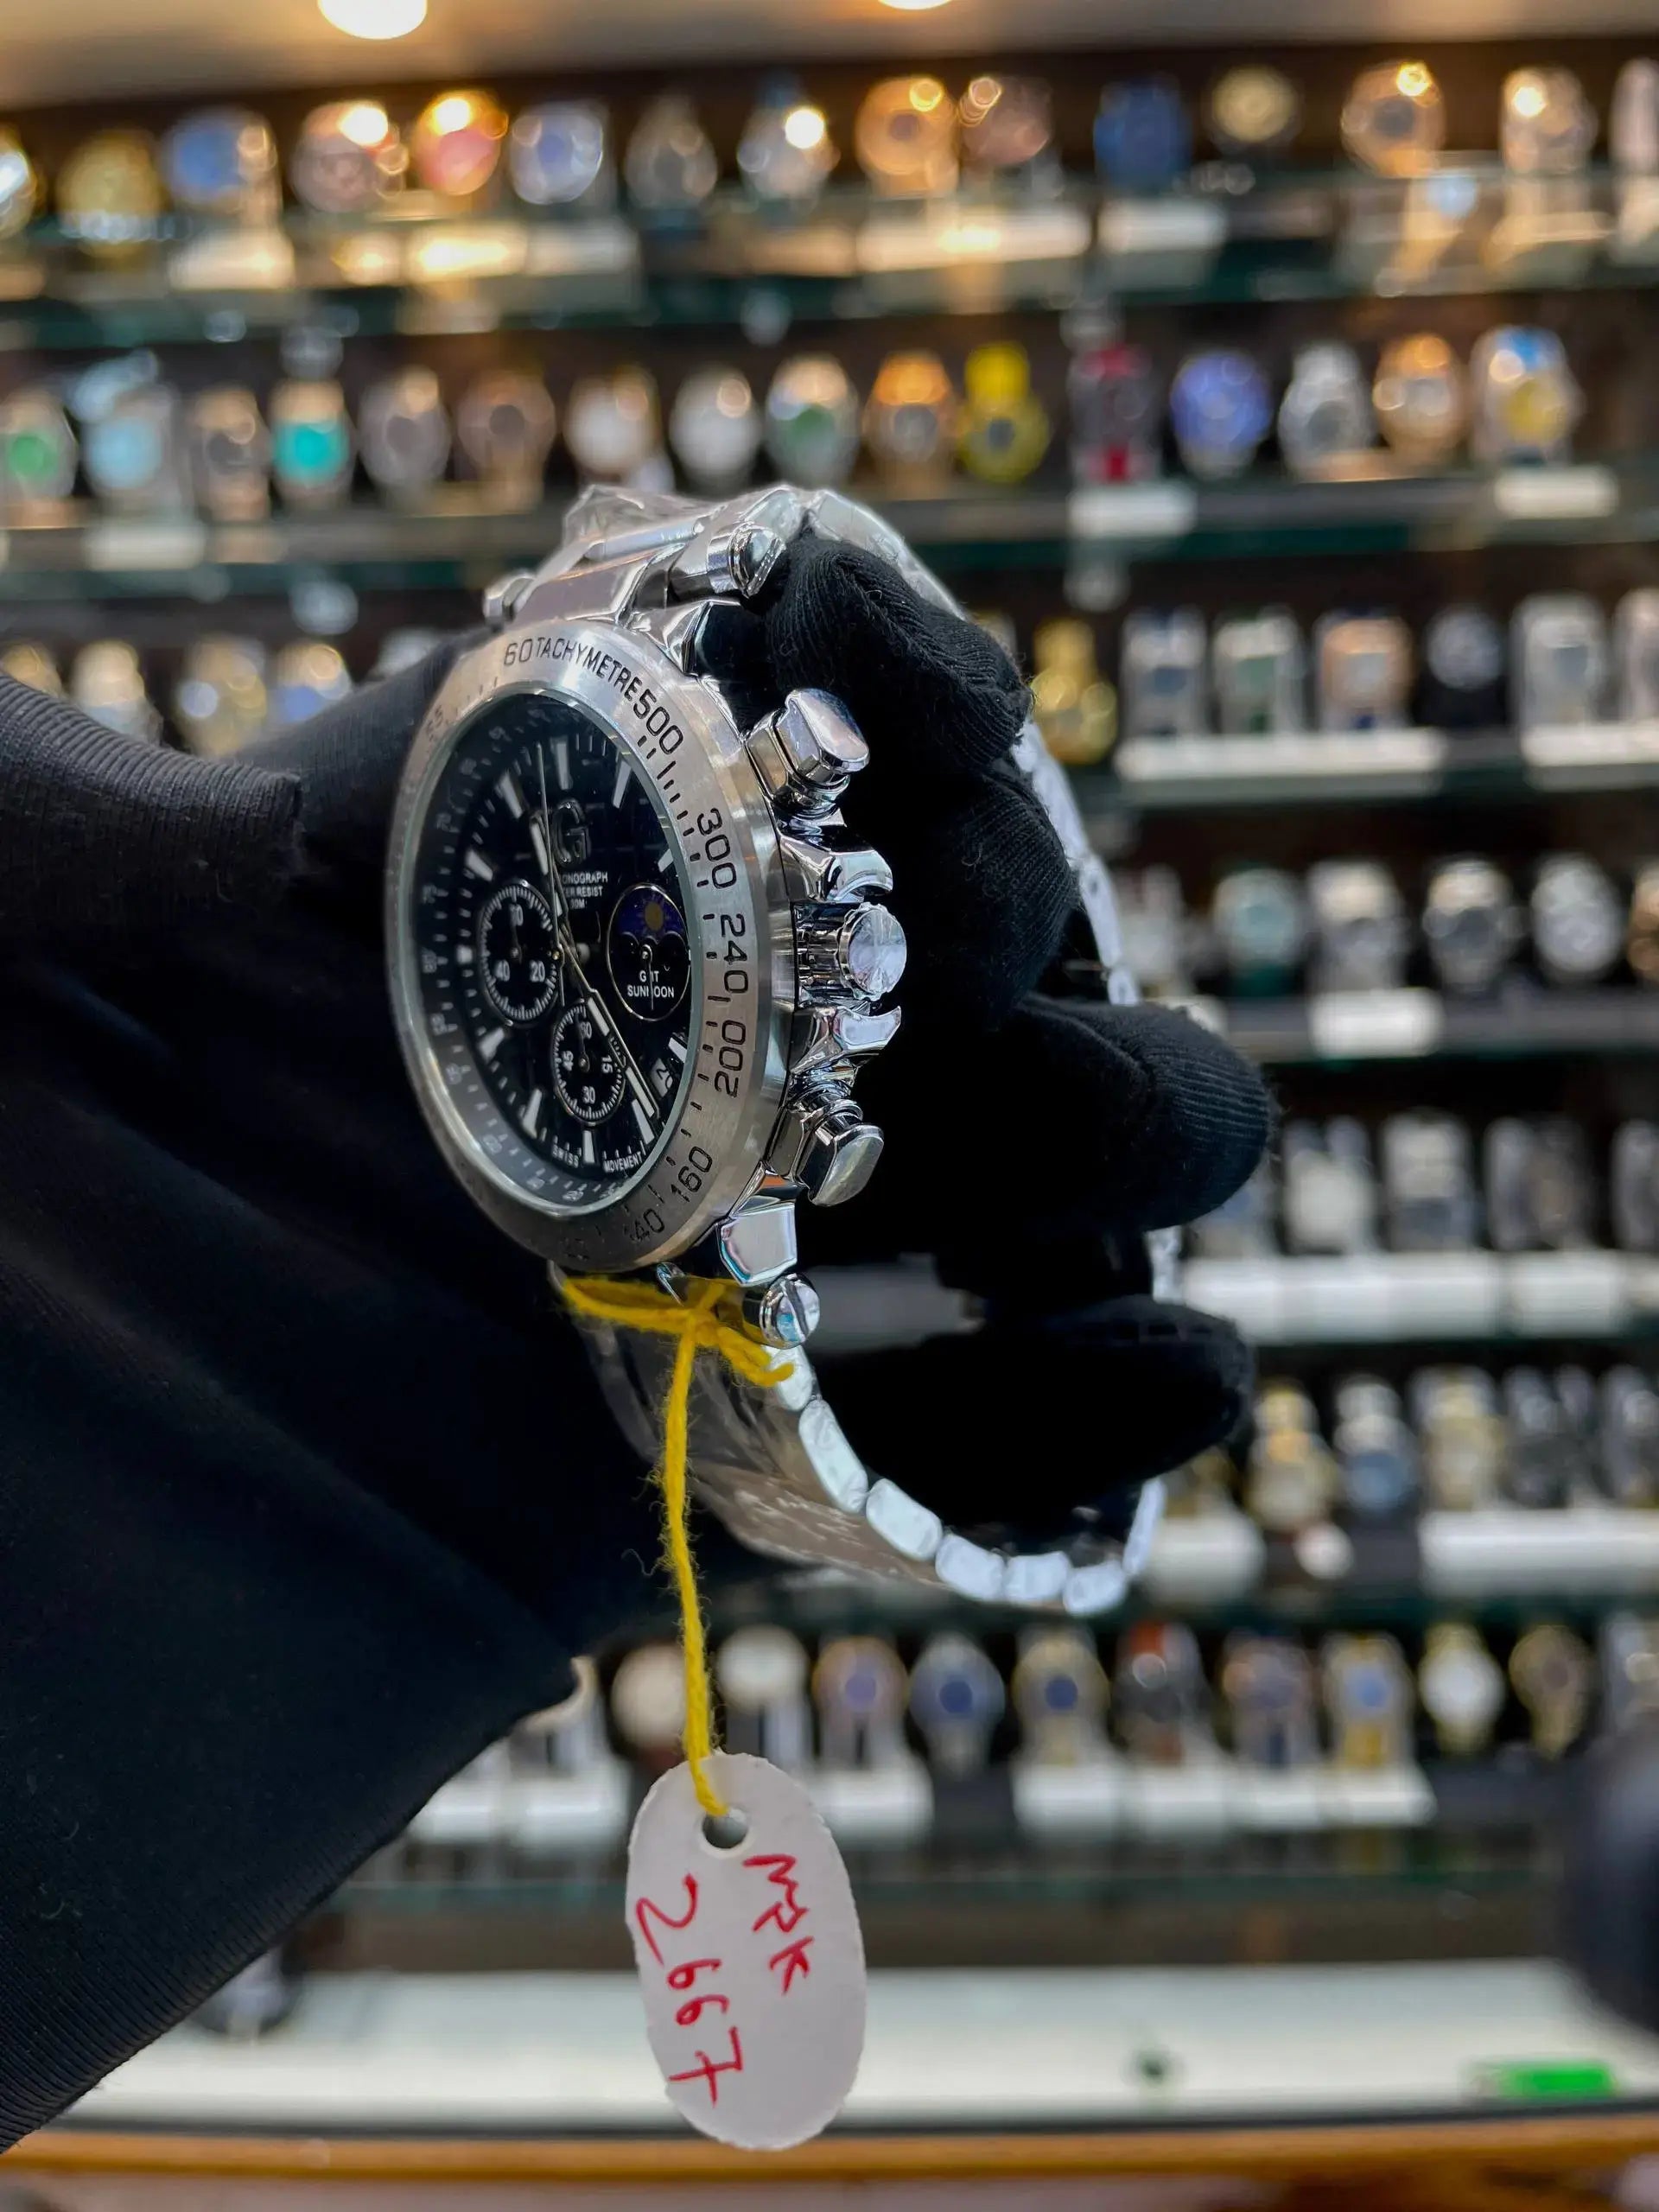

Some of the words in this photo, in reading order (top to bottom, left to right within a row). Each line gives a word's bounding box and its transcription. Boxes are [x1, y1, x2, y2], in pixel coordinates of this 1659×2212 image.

[503, 639, 532, 666] 60
[536, 637, 642, 702] TACHYMETRE
[632, 688, 683, 755] 500
[696, 808, 737, 889] 300
[559, 871, 608, 885] ONOGRAPH
[528, 958, 546, 983] 20
[721, 914, 749, 994] 240
[601, 1054, 613, 1074] 15
[714, 1020, 747, 1098] 200
[582, 1085, 596, 1105] 30
[551, 1143, 579, 1168] SWISS
[603, 1151, 644, 1173] MOVEMENT
[671, 1146, 713, 1203] 160
[635, 1872, 744, 2108] 2667
